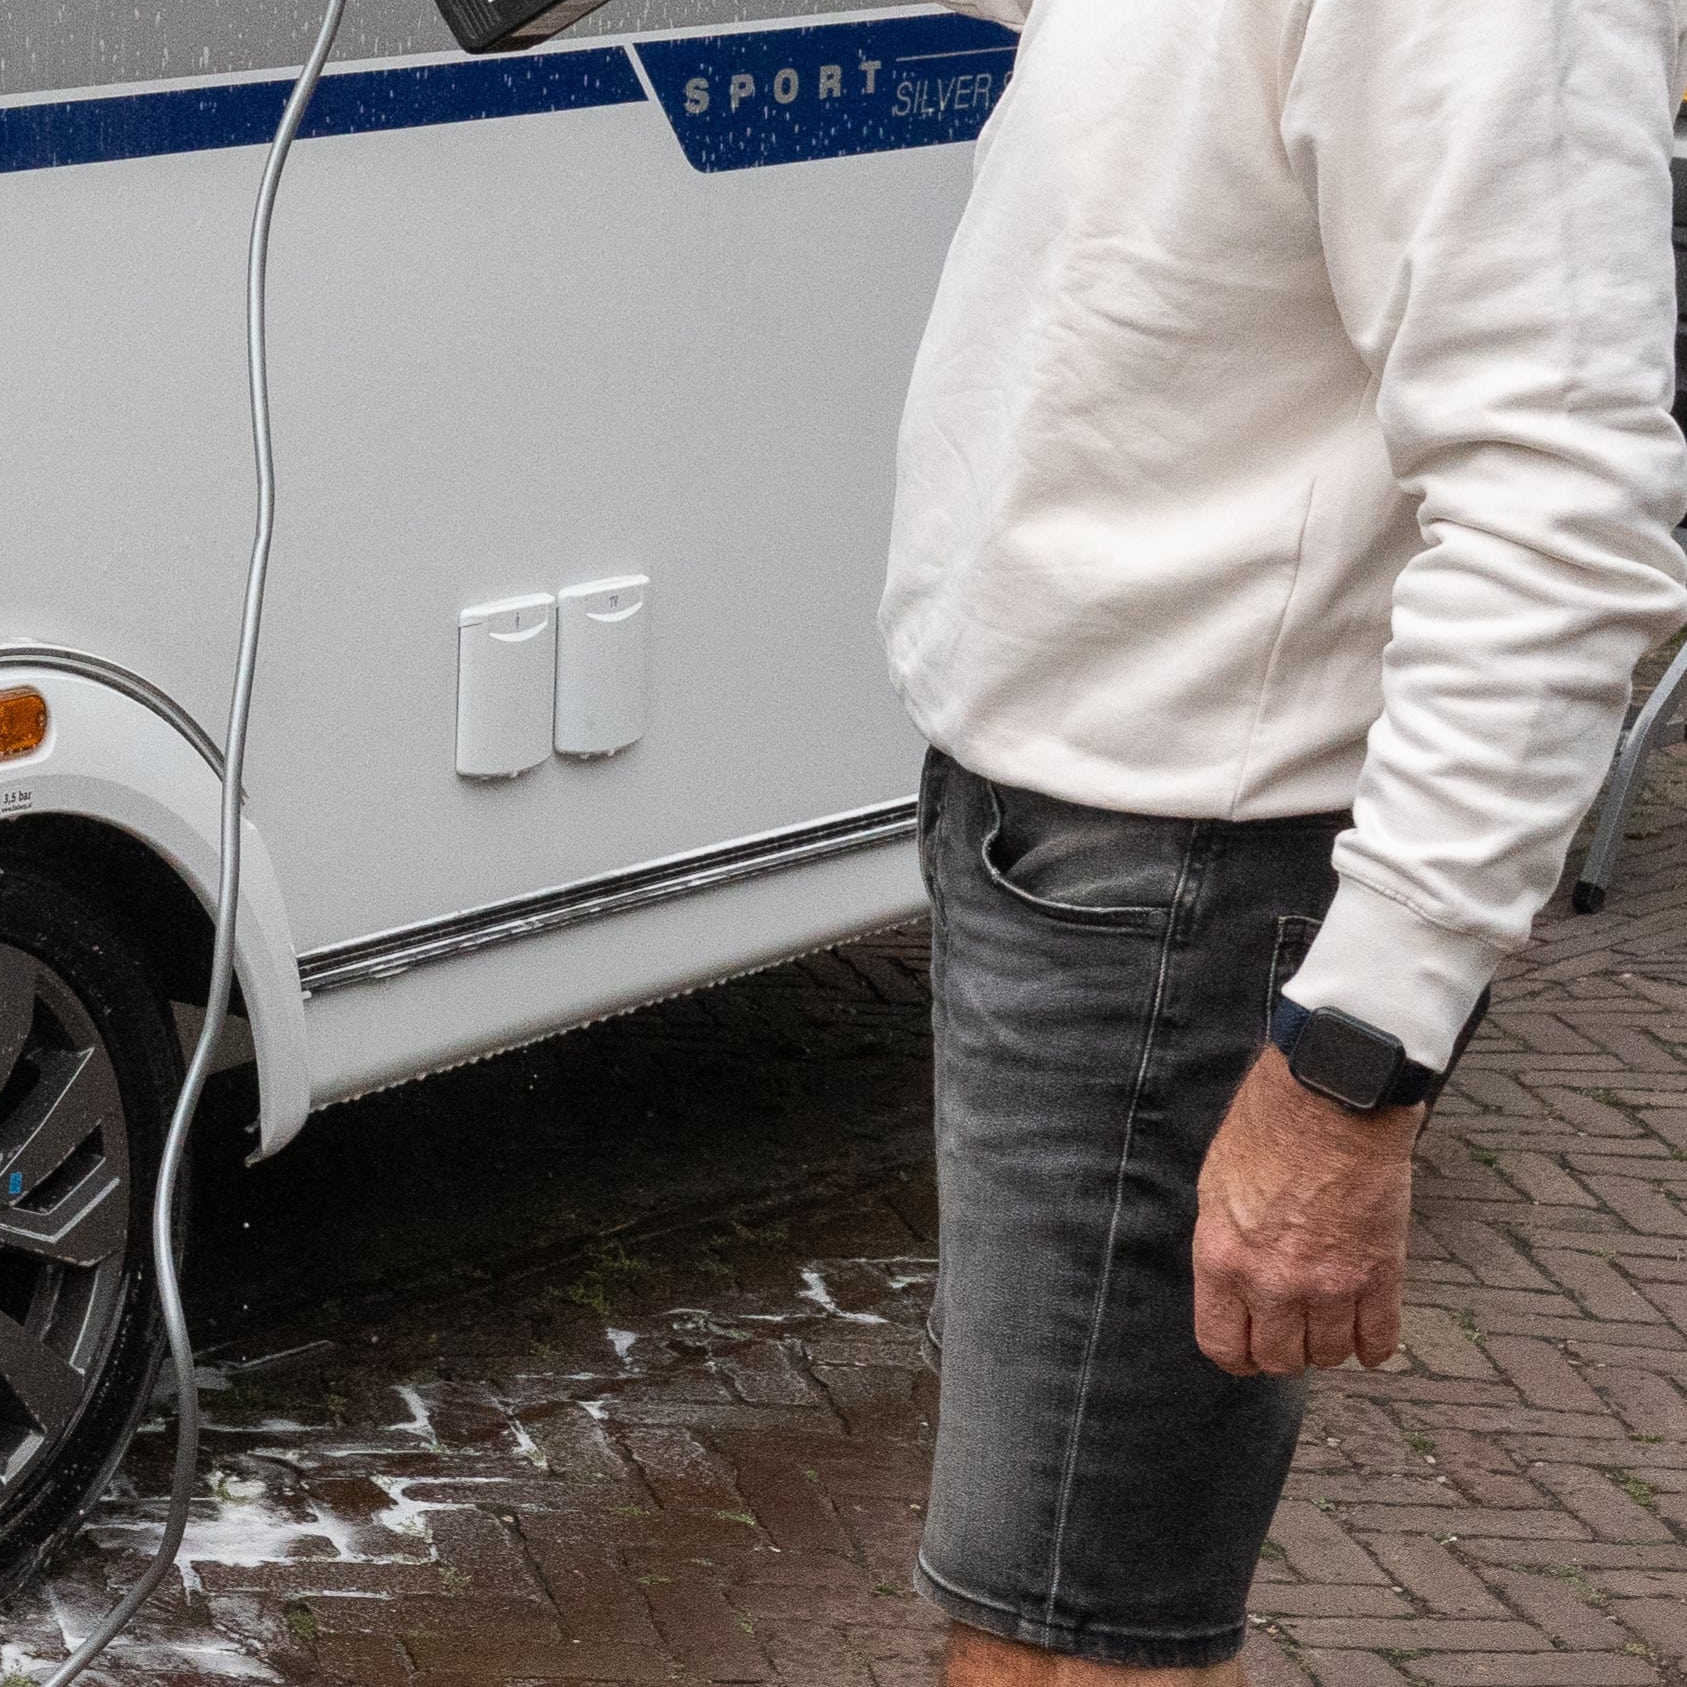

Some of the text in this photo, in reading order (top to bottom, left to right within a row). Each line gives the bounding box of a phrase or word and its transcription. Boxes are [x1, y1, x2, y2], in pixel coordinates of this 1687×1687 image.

[685, 61, 992, 116] SPORT SILVER
[3, 790, 32, 805] 3,5 bar
